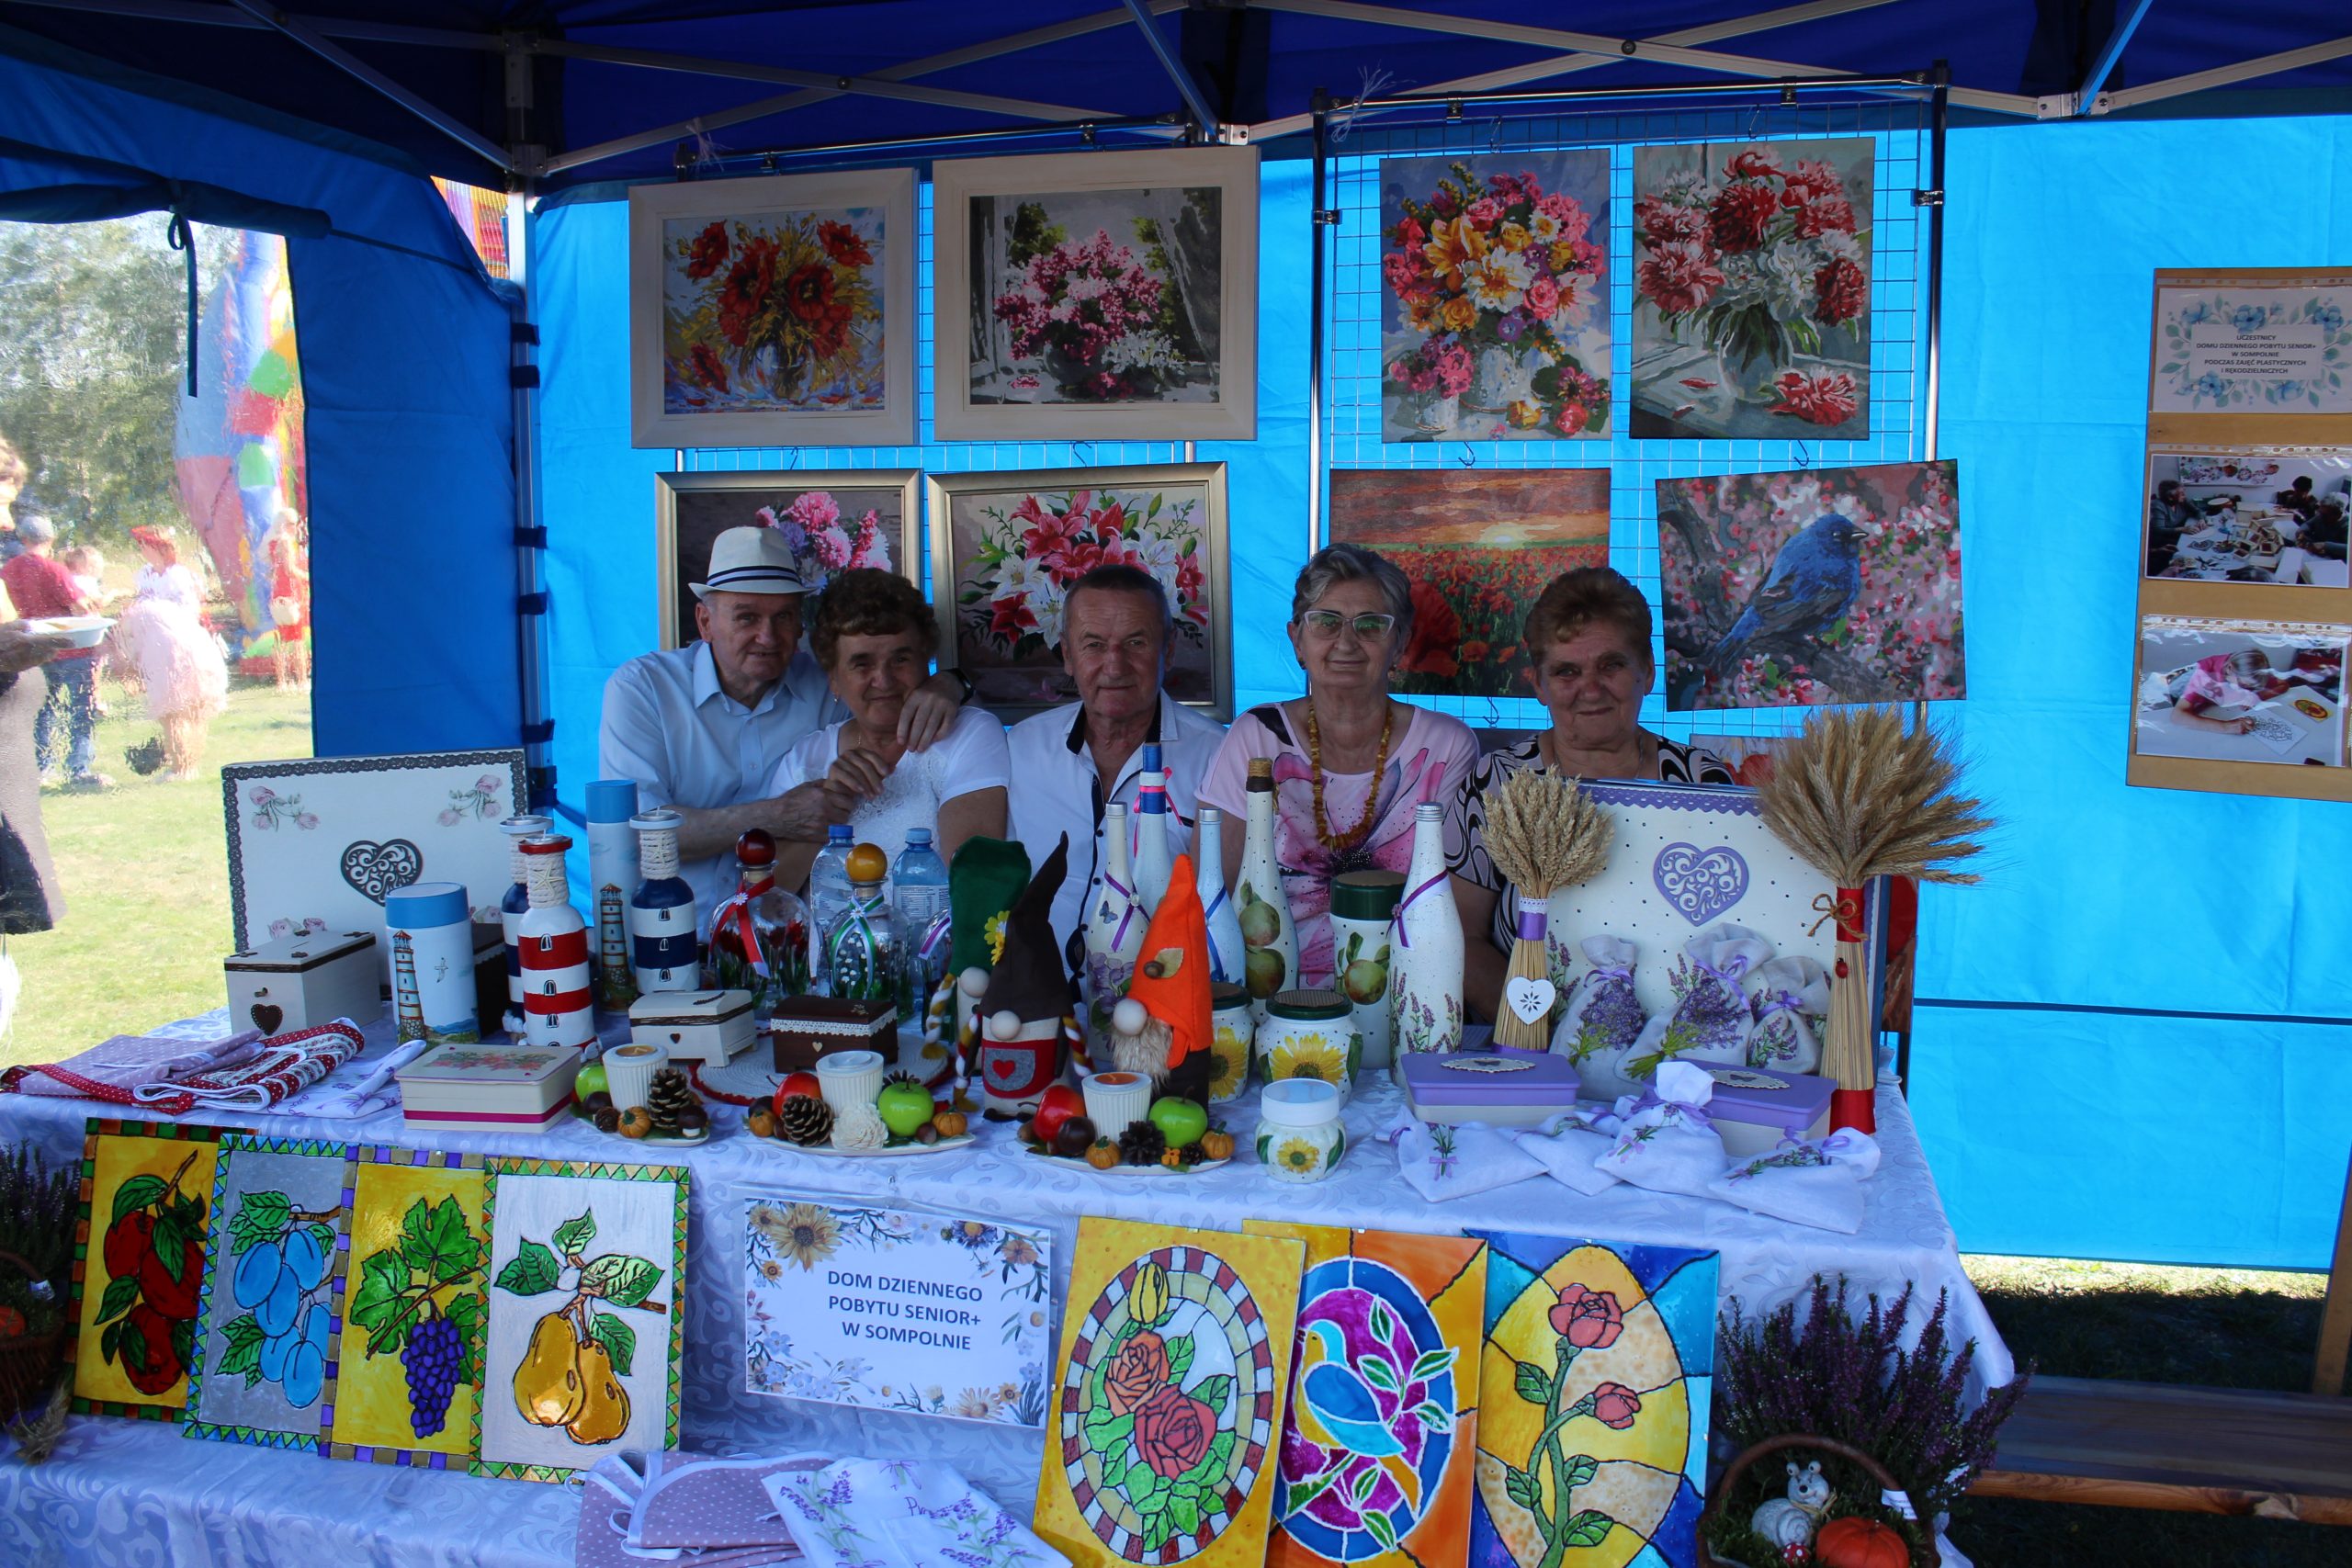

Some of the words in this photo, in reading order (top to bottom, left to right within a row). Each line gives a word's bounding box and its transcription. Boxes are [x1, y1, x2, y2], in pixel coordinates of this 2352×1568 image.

[828, 1270, 873, 1290] DOM
[878, 1276, 983, 1303] DZIENNEGO
[829, 1295, 899, 1317] POBYTU
[905, 1304, 981, 1326] SENIOR+
[842, 1321, 860, 1337] W
[865, 1324, 971, 1350] SOMPOLNIE
